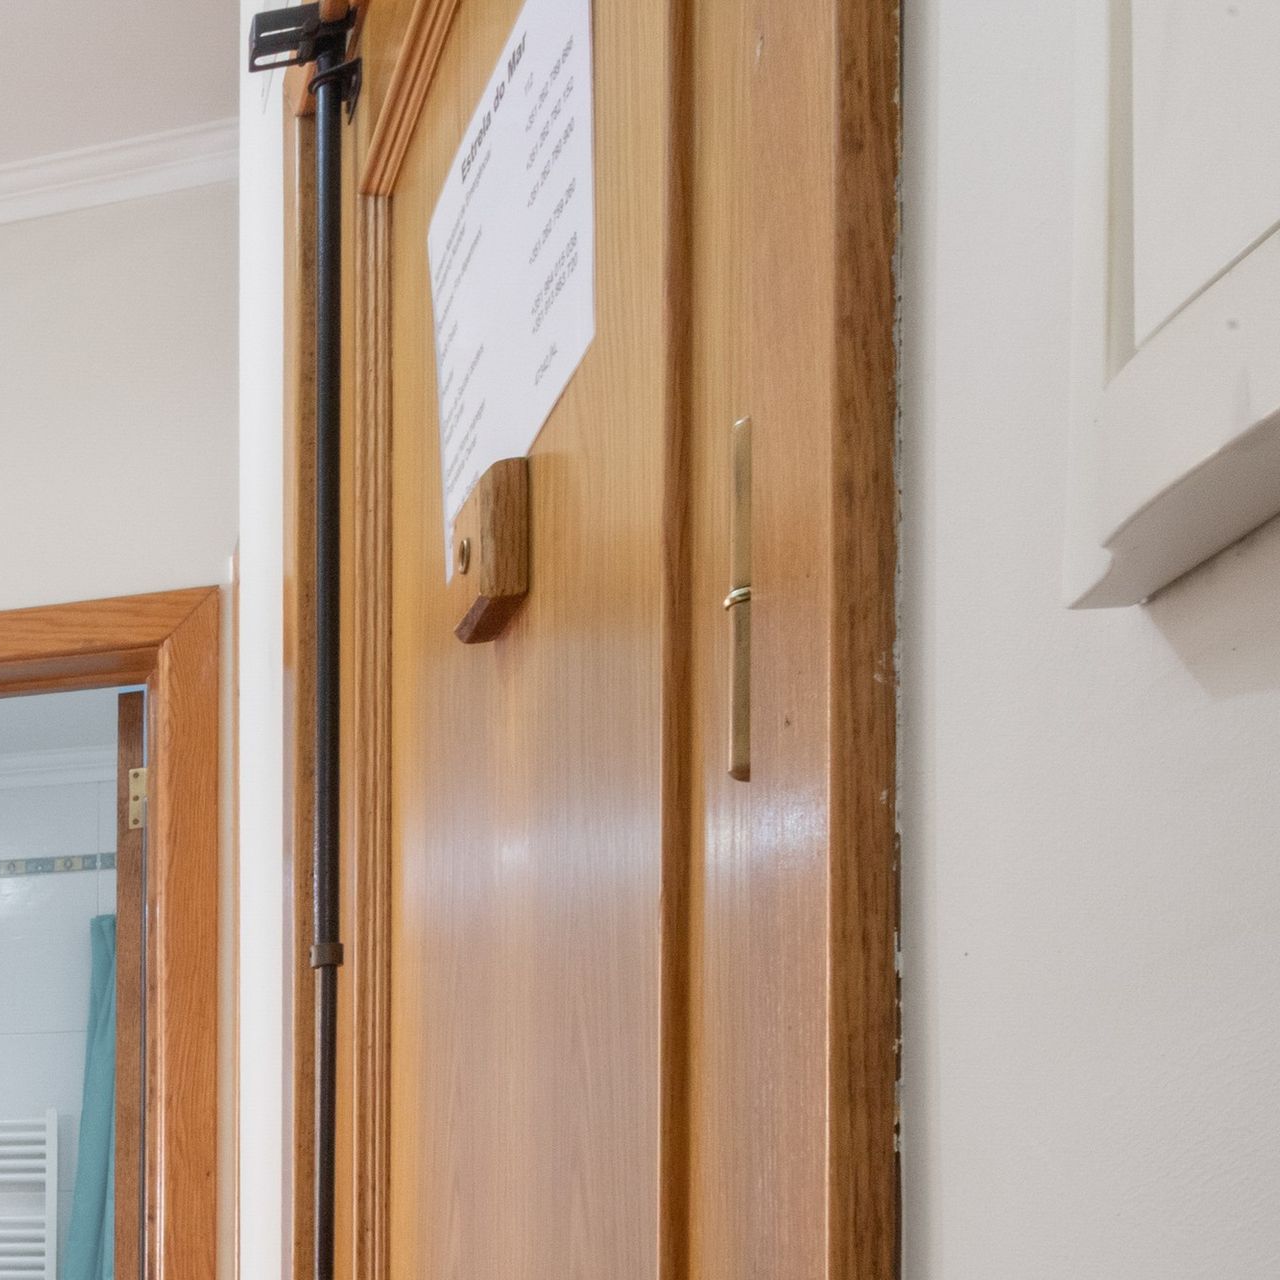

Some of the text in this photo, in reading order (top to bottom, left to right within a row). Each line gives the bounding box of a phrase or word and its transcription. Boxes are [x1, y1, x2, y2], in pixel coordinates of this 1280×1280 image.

[461, 31, 527, 183] Estrela do Mar
